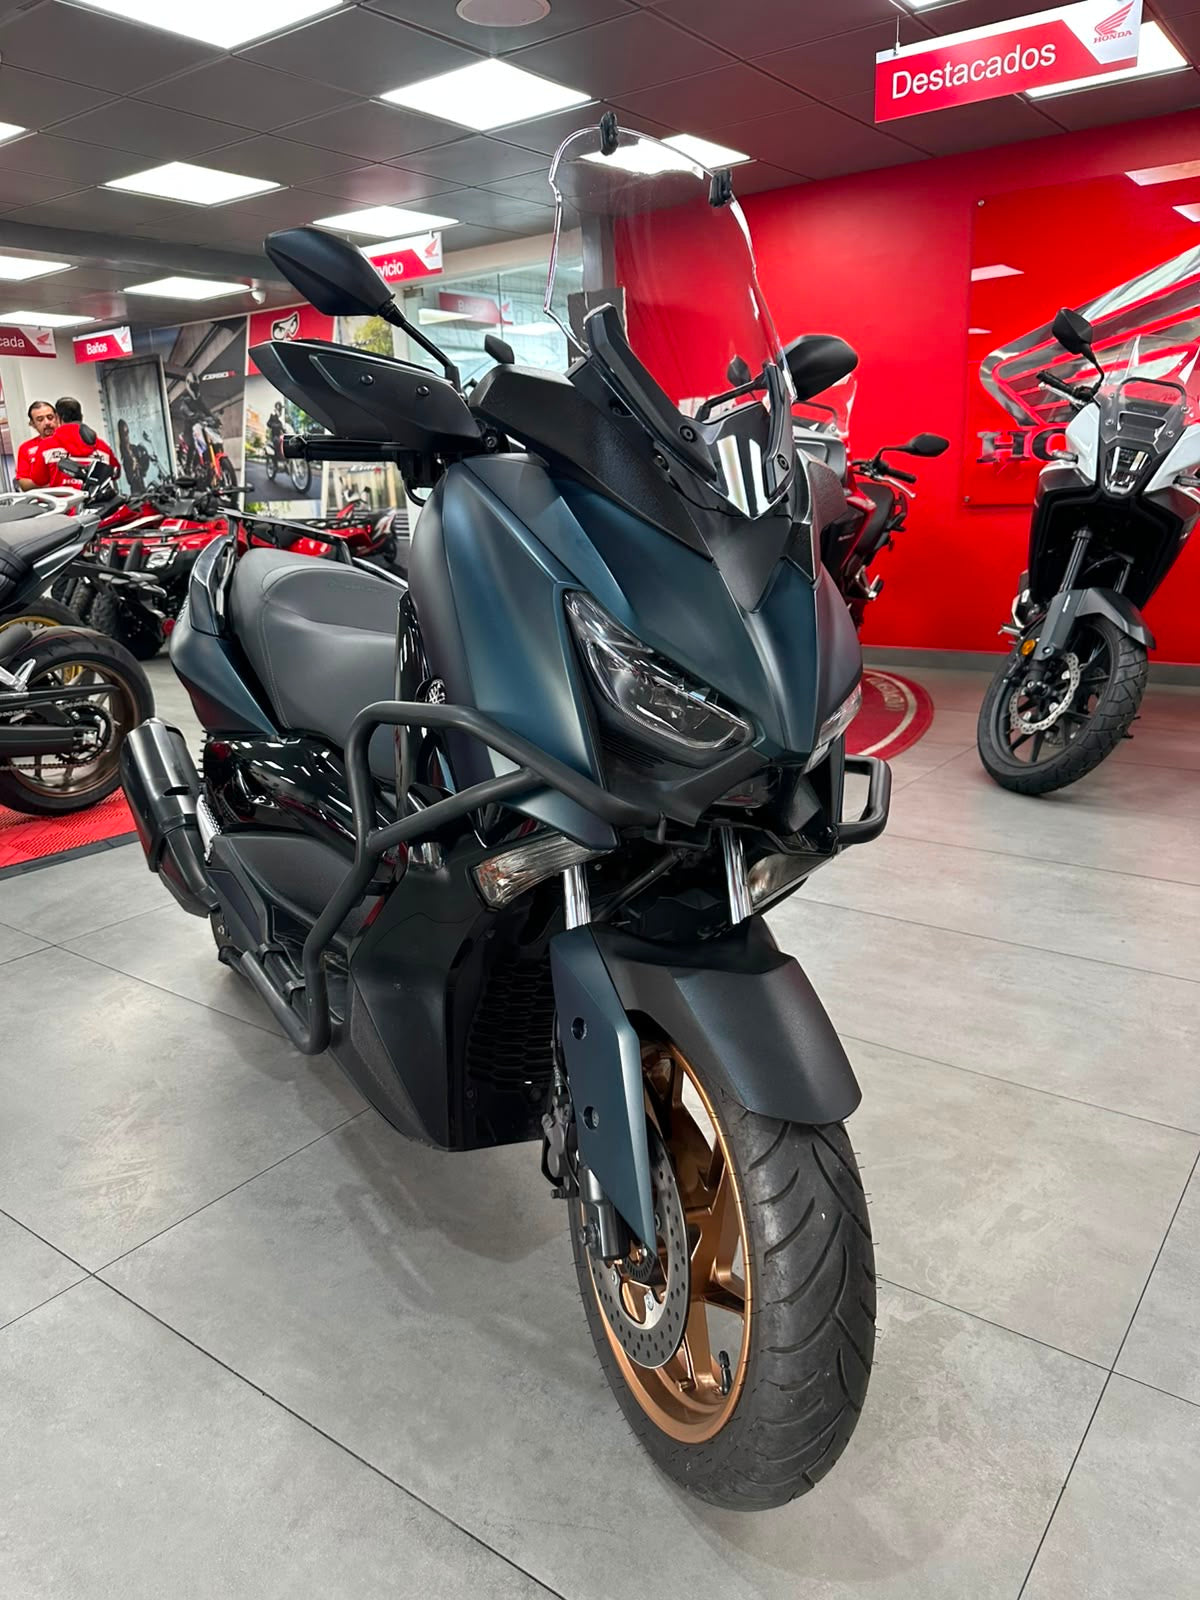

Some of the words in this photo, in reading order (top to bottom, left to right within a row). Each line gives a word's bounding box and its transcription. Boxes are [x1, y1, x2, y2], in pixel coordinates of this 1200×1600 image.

[1093, 29, 1133, 44] HONDA
[891, 43, 1057, 99] Destacados
[86, 341, 108, 355] Baños
